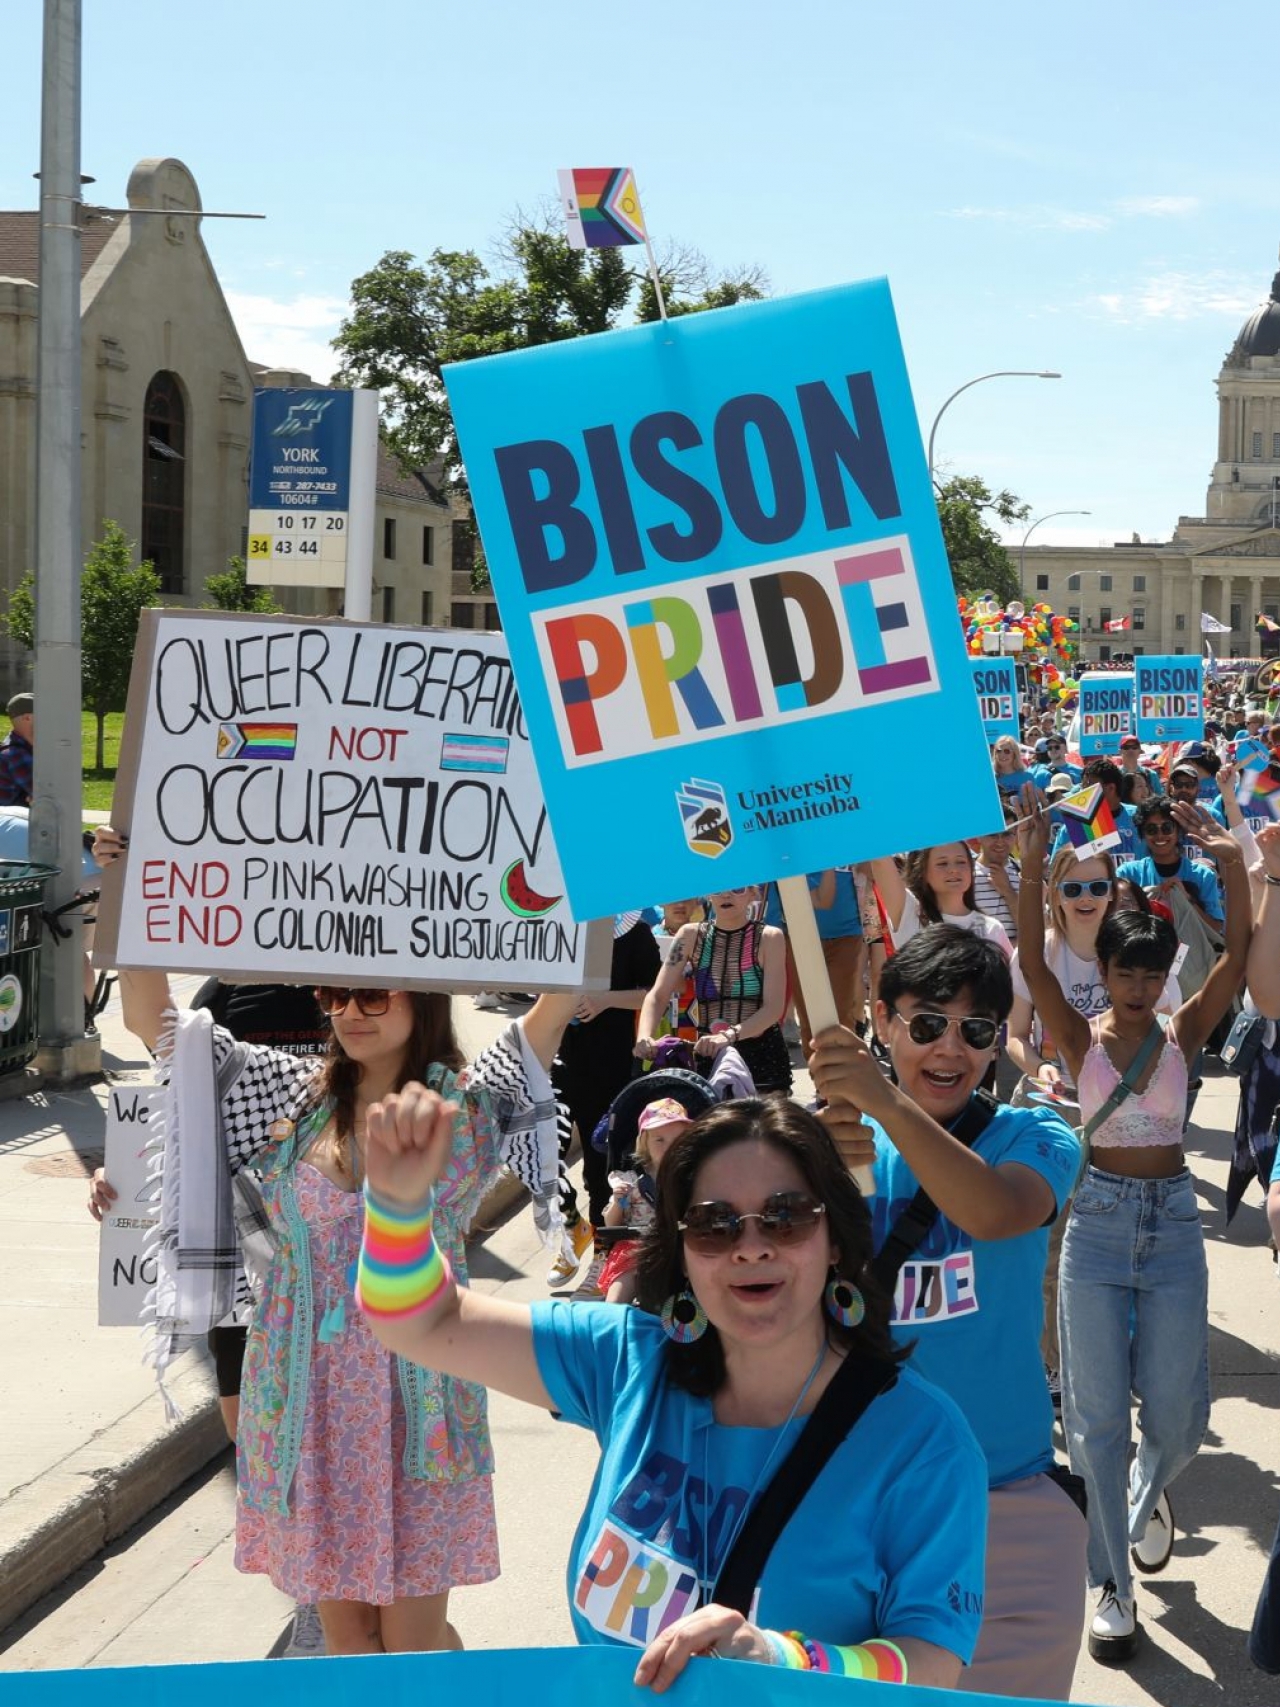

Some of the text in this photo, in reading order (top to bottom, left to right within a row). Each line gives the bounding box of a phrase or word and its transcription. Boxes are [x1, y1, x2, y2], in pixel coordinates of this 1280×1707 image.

[273, 466, 327, 475] NORTHBOUND
[282, 448, 320, 462] YORK
[494, 371, 902, 594] BISON
[278, 516, 344, 530] 10 17 20
[251, 541, 317, 555] 34 43 44
[545, 547, 932, 756] PRIDE
[156, 629, 529, 740] QUEER LIBERATI
[973, 670, 1011, 693] SON
[1140, 669, 1199, 692] BISON
[982, 697, 1012, 718] IDE
[1083, 689, 1130, 711] BISON
[1141, 695, 1198, 717] PRIDE
[1084, 713, 1129, 735] PRIDE
[328, 726, 408, 761] NOT
[737, 773, 853, 810] University
[157, 764, 547, 867] OCCUPATION
[743, 795, 860, 832] of Manitoba
[143, 860, 229, 899] END
[147, 905, 579, 963] END COLONIAL SUBJUGATION
[113, 1093, 150, 1124] We
[901, 1256, 976, 1322] IDE
[577, 1528, 698, 1643] PRI
